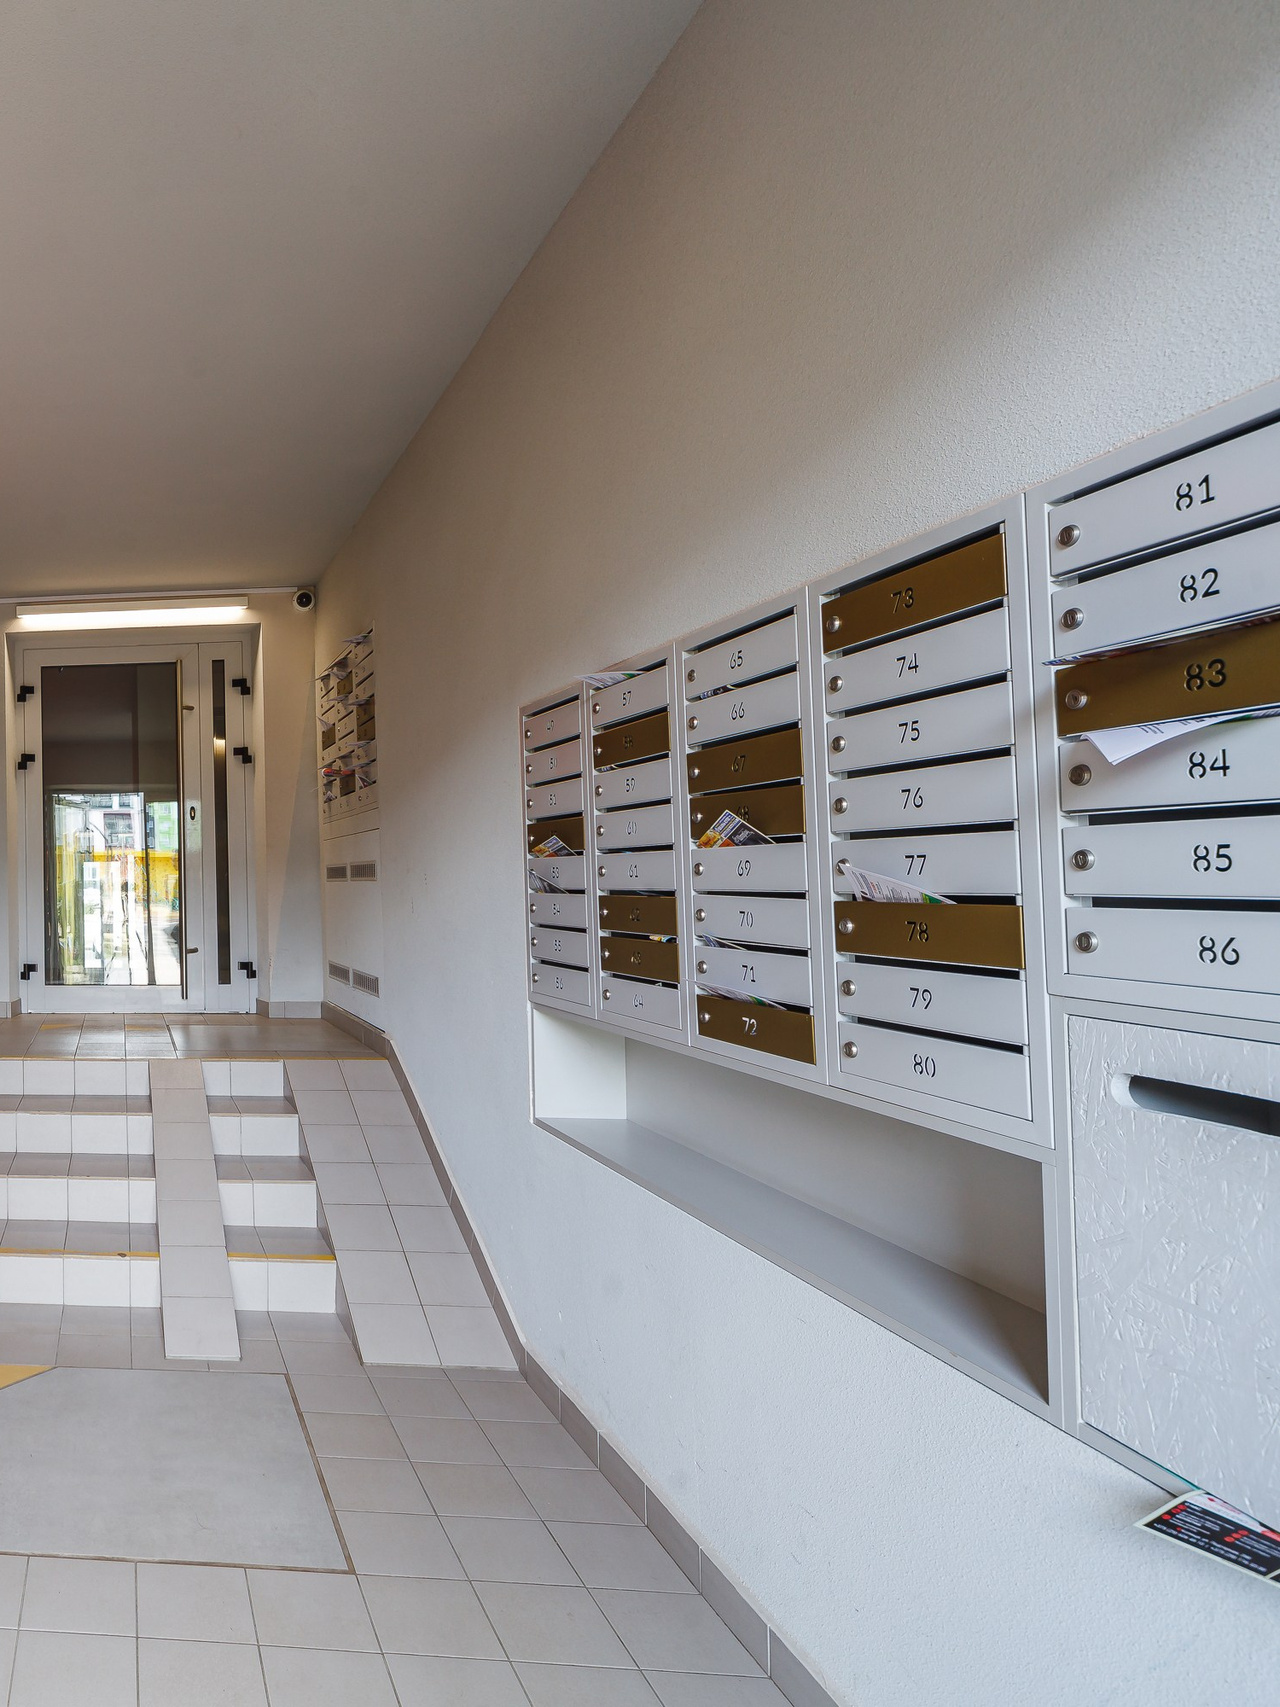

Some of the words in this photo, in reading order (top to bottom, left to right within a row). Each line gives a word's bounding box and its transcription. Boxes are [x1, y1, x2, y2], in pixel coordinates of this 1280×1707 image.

[1174, 474, 1216, 513] 81
[1179, 567, 1221, 603] 82
[891, 587, 915, 613] 73
[729, 650, 744, 669] 65
[896, 652, 919, 679] 74
[1184, 658, 1228, 692] 83
[622, 690, 632, 706] 57
[730, 702, 745, 720] 66
[898, 720, 921, 744] 75
[732, 755, 746, 773] 67
[1188, 748, 1231, 780] 84
[625, 778, 636, 792] 59
[549, 794, 557, 806] 51
[900, 786, 924, 810] 76
[904, 854, 927, 876] 77
[1192, 843, 1234, 874] 85
[552, 866, 560, 879] 53
[628, 864, 639, 878] 61
[736, 860, 752, 877] 69
[552, 903, 561, 916] 54
[739, 910, 754, 928] 70
[906, 921, 929, 943] 78
[554, 939, 562, 952] 55
[1198, 934, 1241, 966] 86
[742, 964, 756, 982] 71
[555, 977, 564, 990] 56
[633, 994, 644, 1008] 64
[909, 986, 933, 1011] 79
[742, 1017, 757, 1036] 72
[912, 1053, 937, 1079] 80
